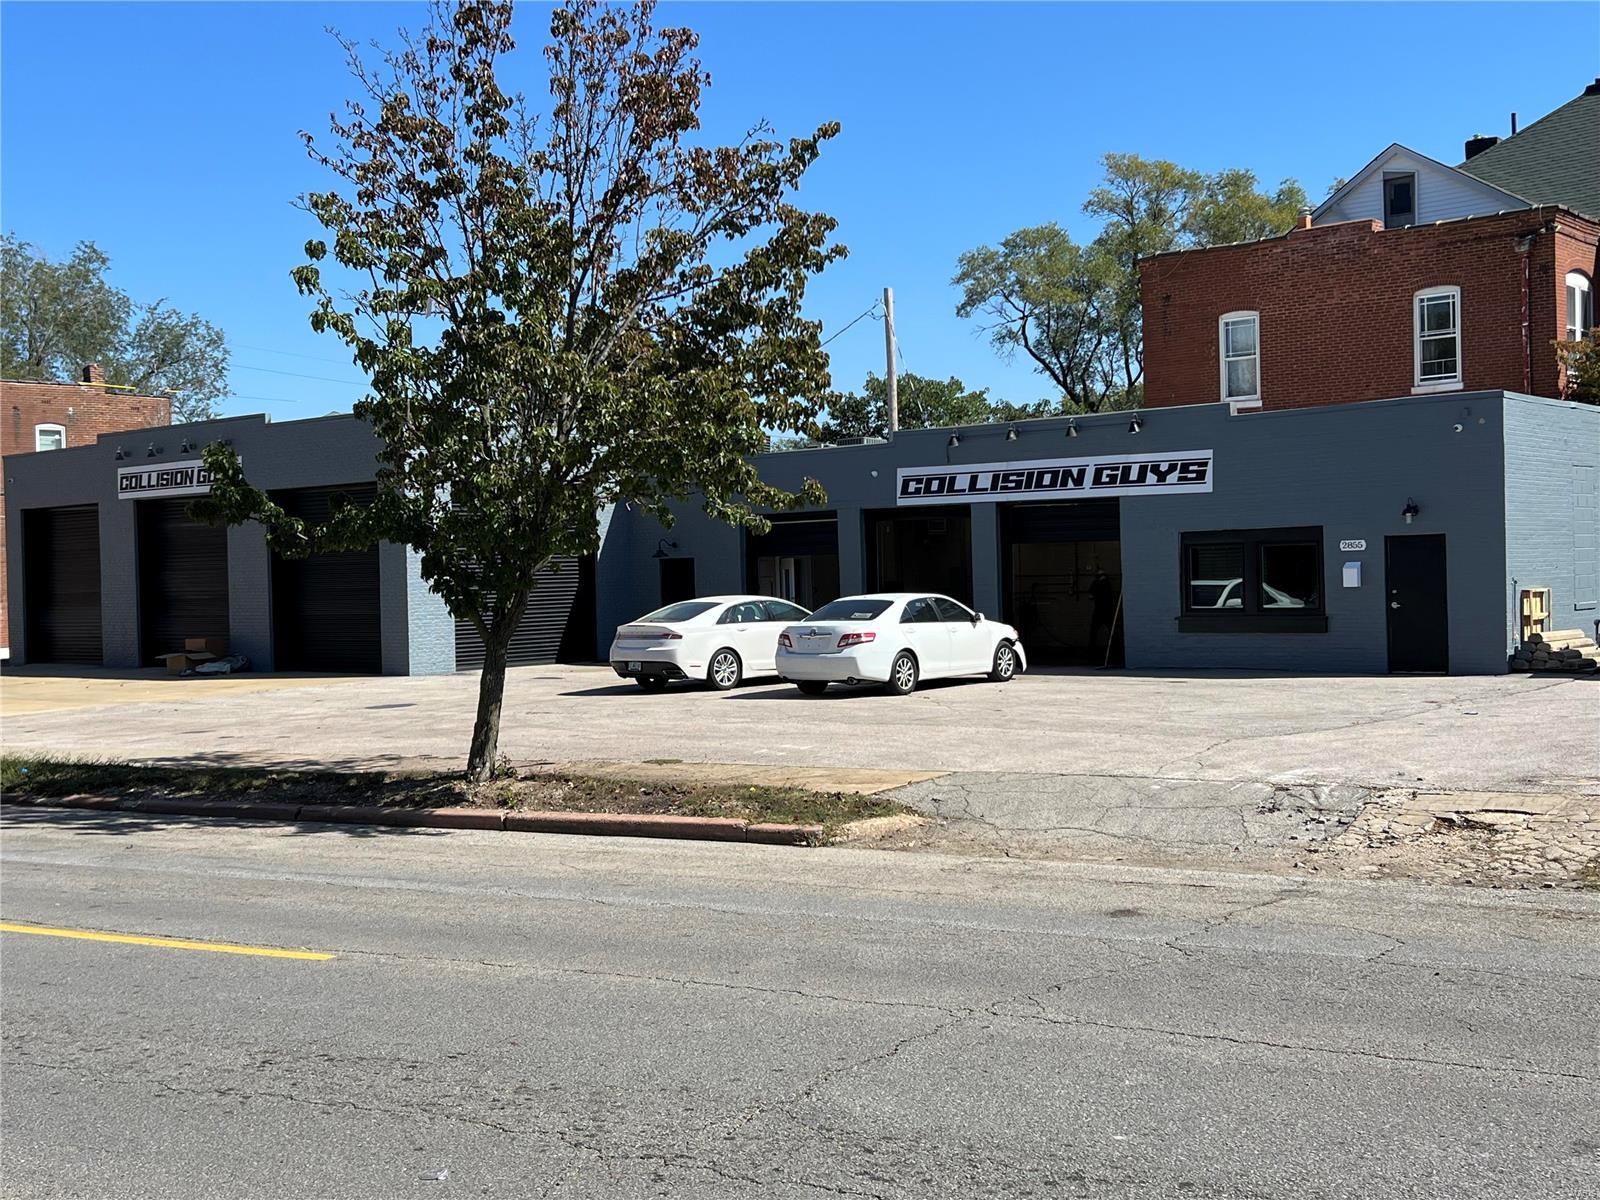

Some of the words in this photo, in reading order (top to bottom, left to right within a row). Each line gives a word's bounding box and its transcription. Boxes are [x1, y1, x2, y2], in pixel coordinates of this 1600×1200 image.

[119, 469, 195, 491] COLLISION
[900, 468, 1087, 496] COLLISION
[1092, 461, 1209, 486] GUYS
[1341, 541, 1363, 549] 2855
